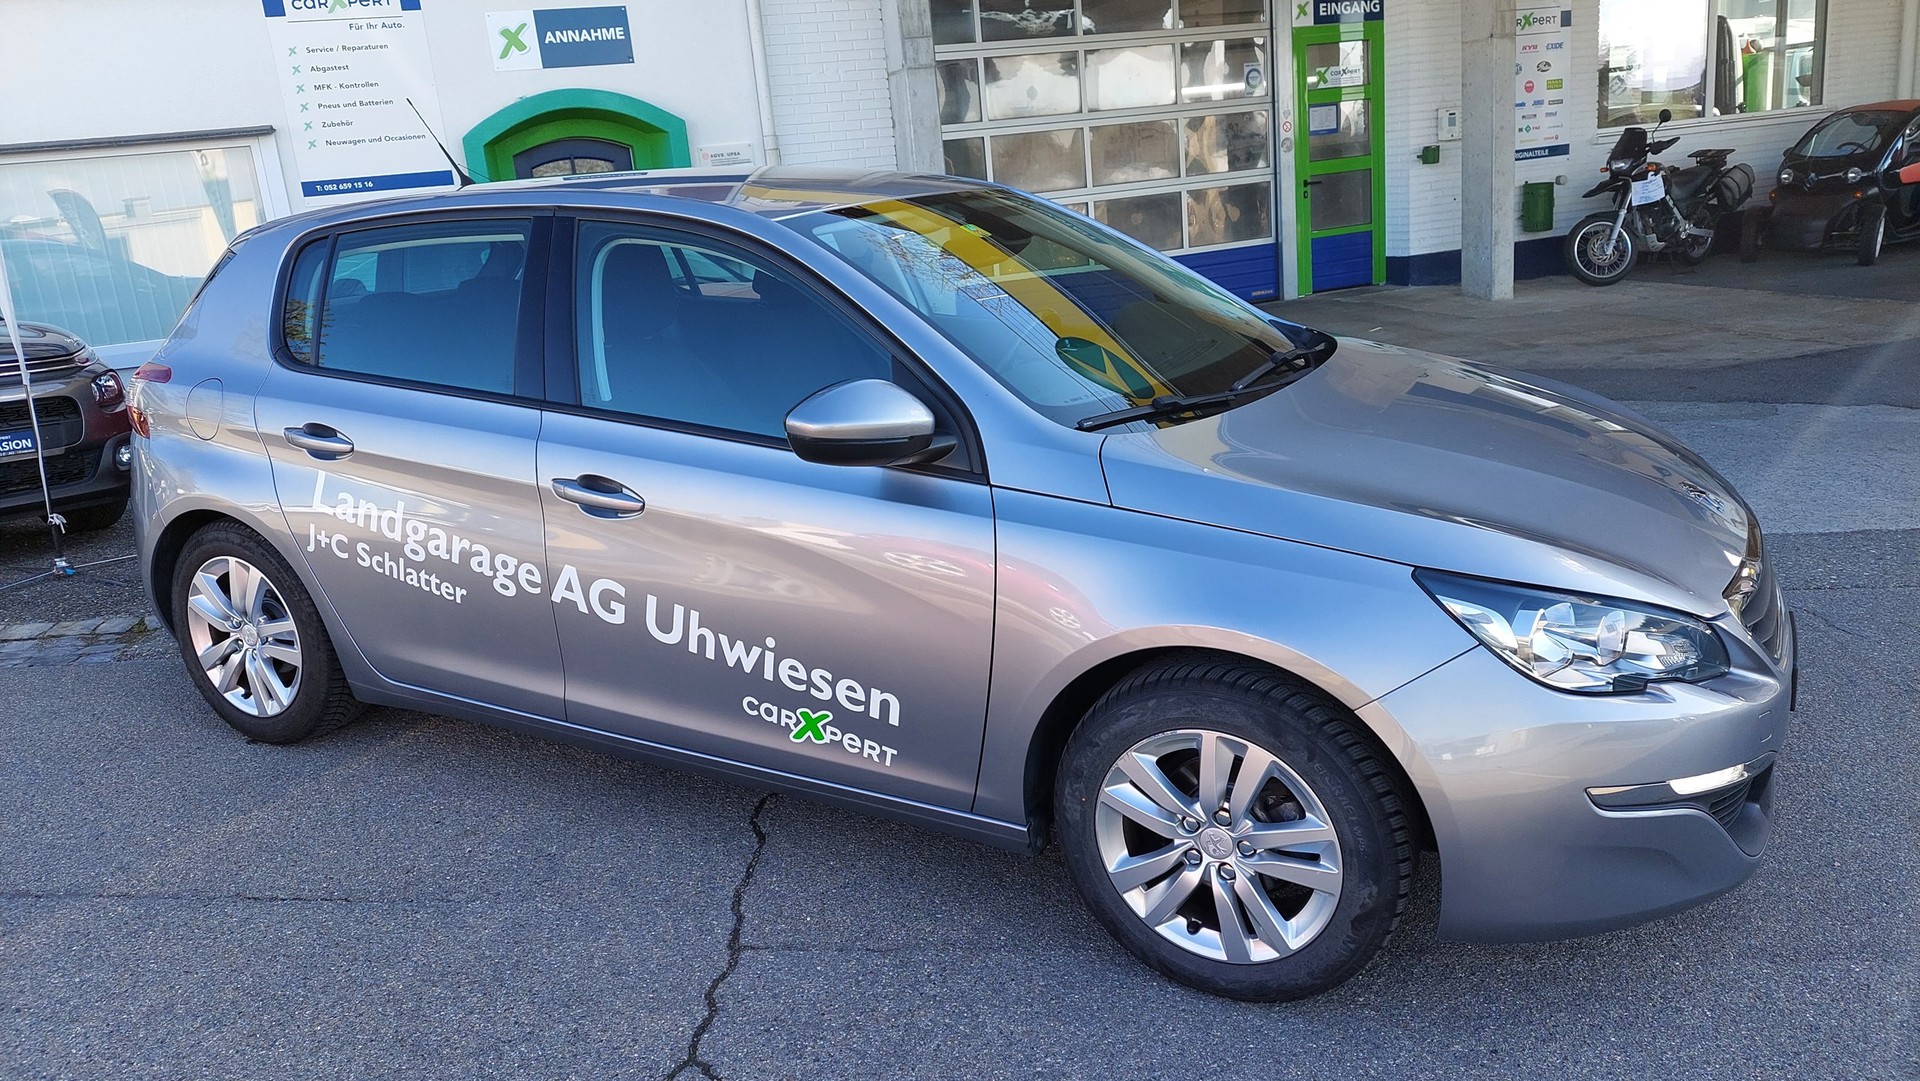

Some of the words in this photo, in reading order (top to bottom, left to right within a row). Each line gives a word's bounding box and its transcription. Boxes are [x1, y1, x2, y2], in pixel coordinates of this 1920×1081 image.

[1319, 0, 1380, 16] EINGANG
[349, 23, 363, 31] Für
[366, 22, 378, 30] Ihr
[381, 21, 405, 29] Auto.
[544, 26, 626, 45] ANNAHME
[305, 46, 334, 54] Service
[341, 43, 389, 52] Reparaturen
[310, 64, 350, 73] Abgastest
[313, 83, 333, 91] MFK
[338, 81, 380, 90] Kontrollen
[317, 102, 341, 110] Pneus
[359, 98, 394, 107] Batterien
[321, 120, 354, 128] Zubehör
[325, 138, 367, 147] Neuwagen
[384, 134, 427, 142] Occasionen
[338, 182, 352, 190] 659
[353, 181, 363, 189] 15
[364, 180, 374, 188] 16
[307, 523, 349, 559] J+C
[356, 542, 467, 604] Schlatter
[312, 470, 542, 598] Landgarage
[551, 564, 627, 625] AG
[645, 594, 901, 727] Uhwiesen
